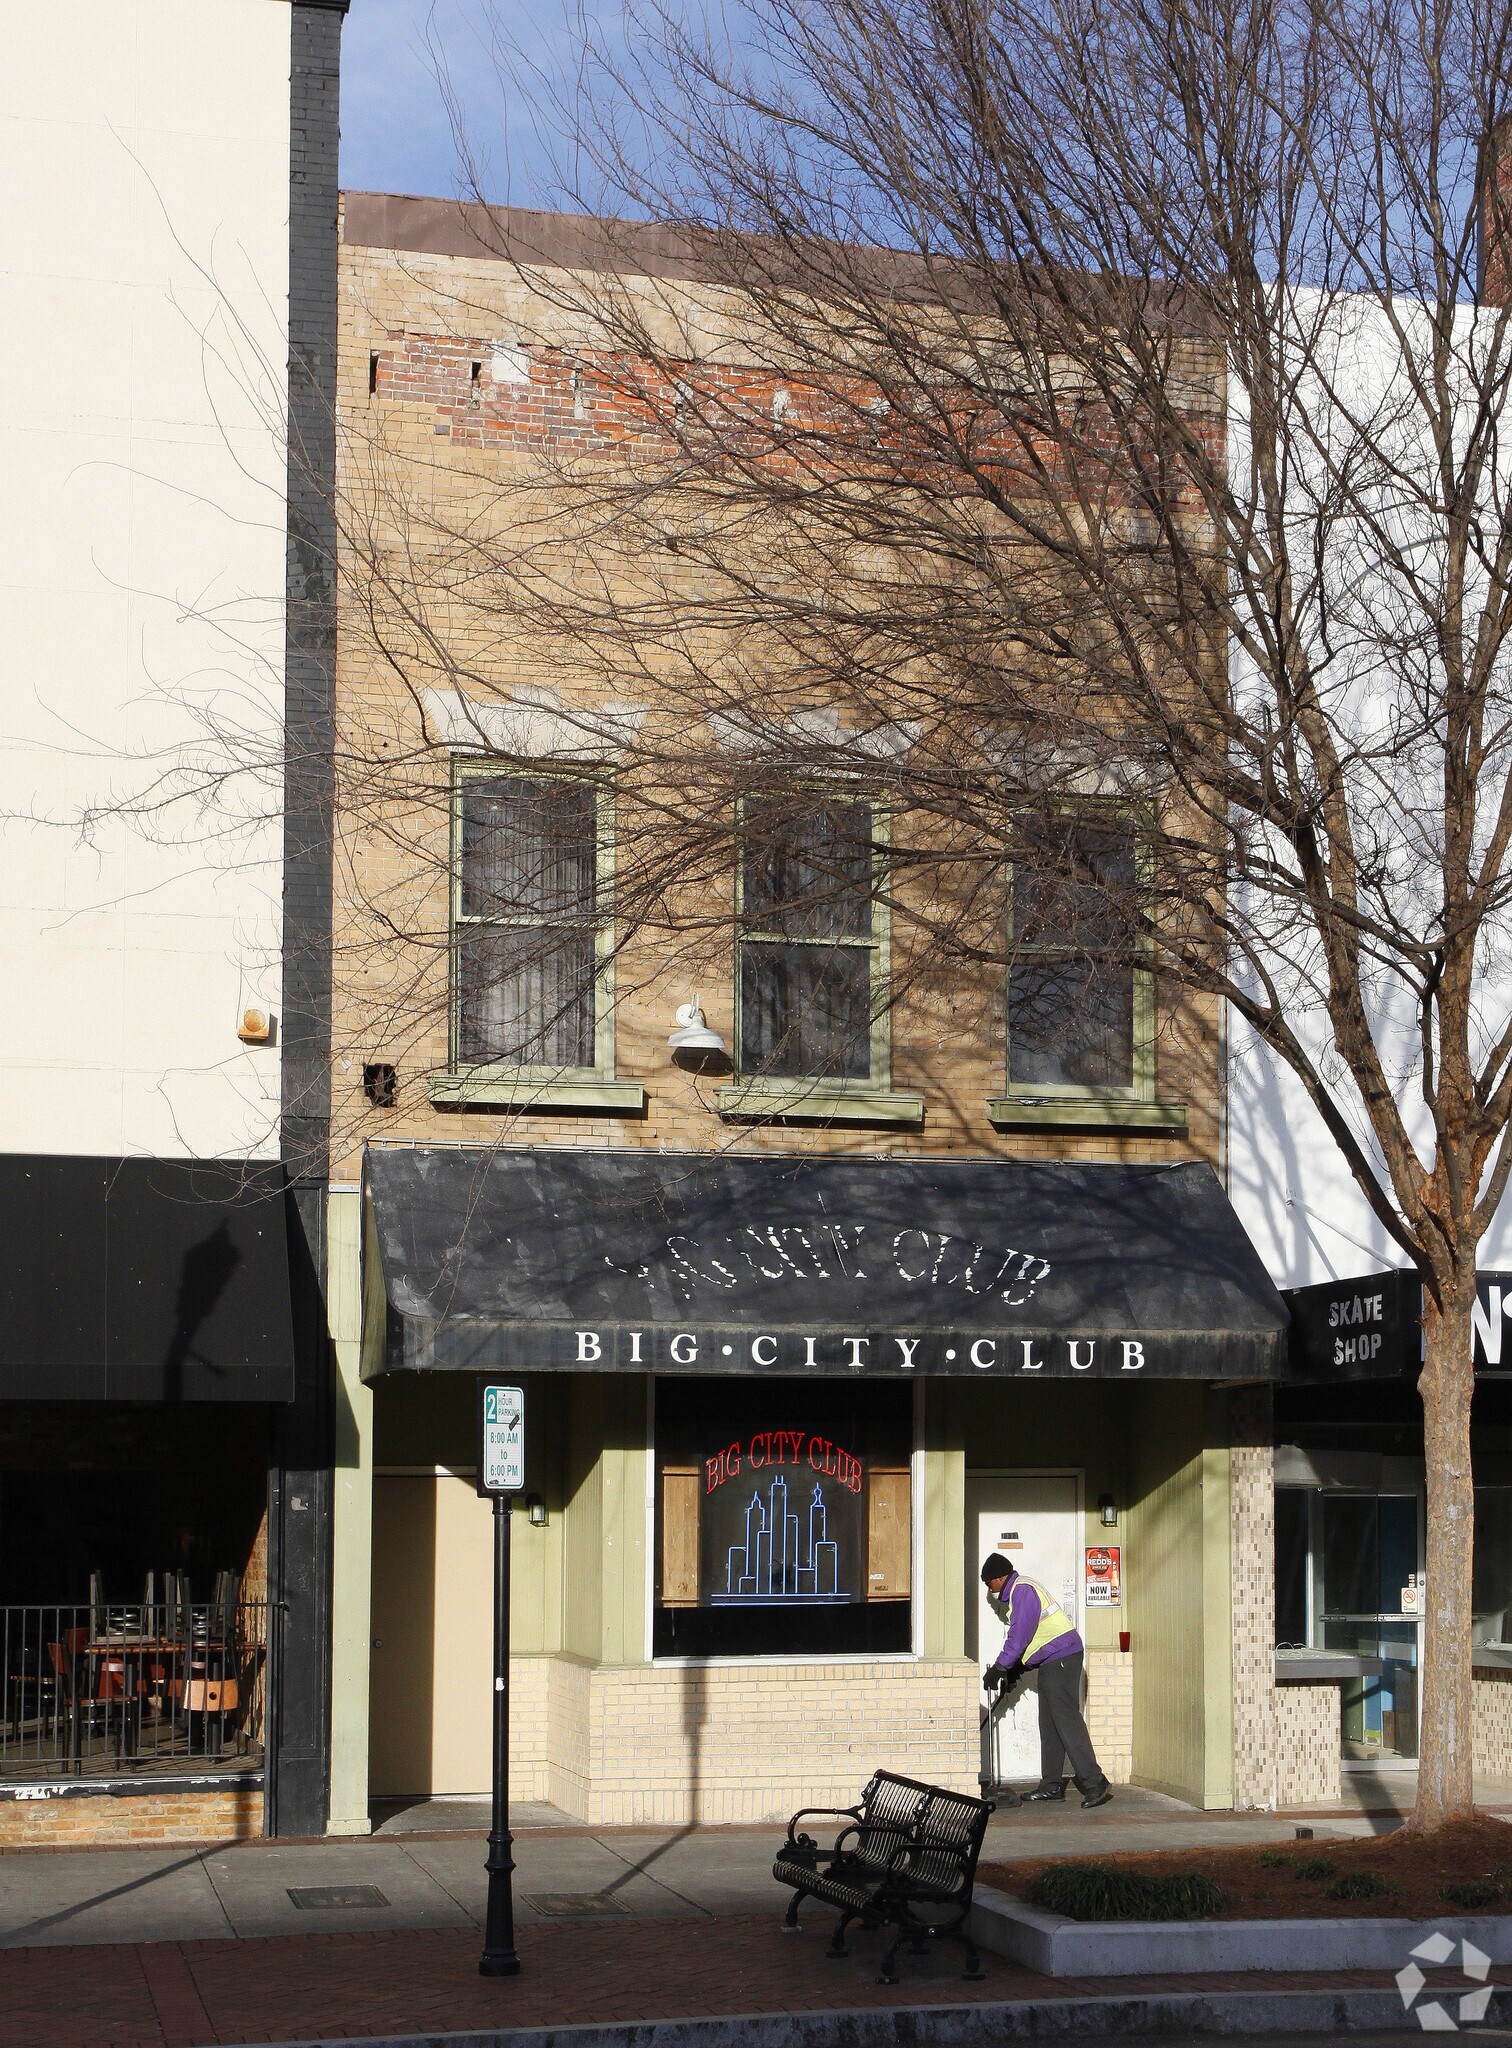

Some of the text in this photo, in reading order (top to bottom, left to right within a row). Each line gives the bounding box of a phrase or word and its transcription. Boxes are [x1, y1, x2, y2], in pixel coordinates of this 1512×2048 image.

[1328, 1293, 1383, 1327] SKATE
[575, 1331, 1145, 1370] BIG CITY CLUB
[1333, 1333, 1382, 1366] SHOP
[487, 1394, 496, 1420] 2
[498, 1398, 513, 1406] HOUR
[490, 1431, 518, 1444] 8:00 AM
[500, 1450, 508, 1460] to
[705, 1431, 862, 1494] BIG CITY CLUB
[490, 1464, 518, 1477] 6:00 PM
[1090, 1586, 1108, 1595] NOW
